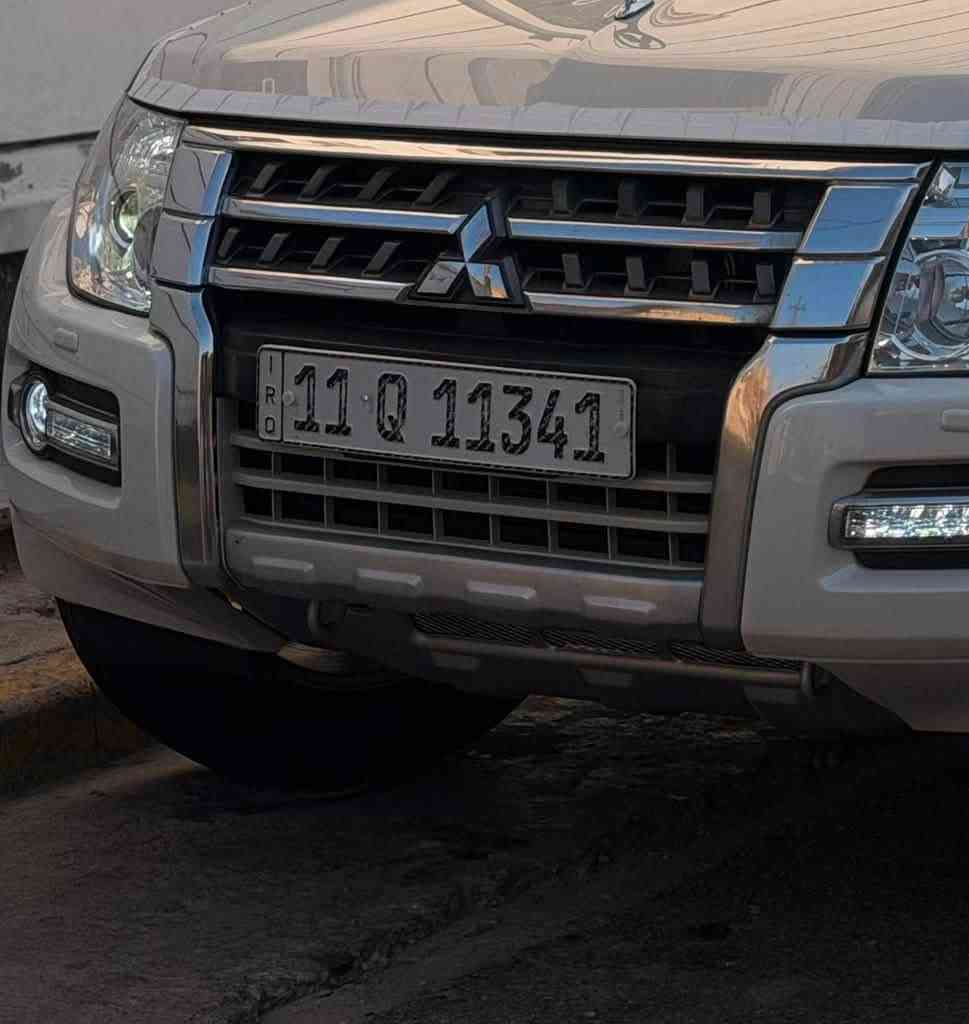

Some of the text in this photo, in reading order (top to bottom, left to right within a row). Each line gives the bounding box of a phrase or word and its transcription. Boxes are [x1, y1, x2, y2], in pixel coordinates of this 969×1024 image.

[294, 365, 605, 463] 11 Q 11341
